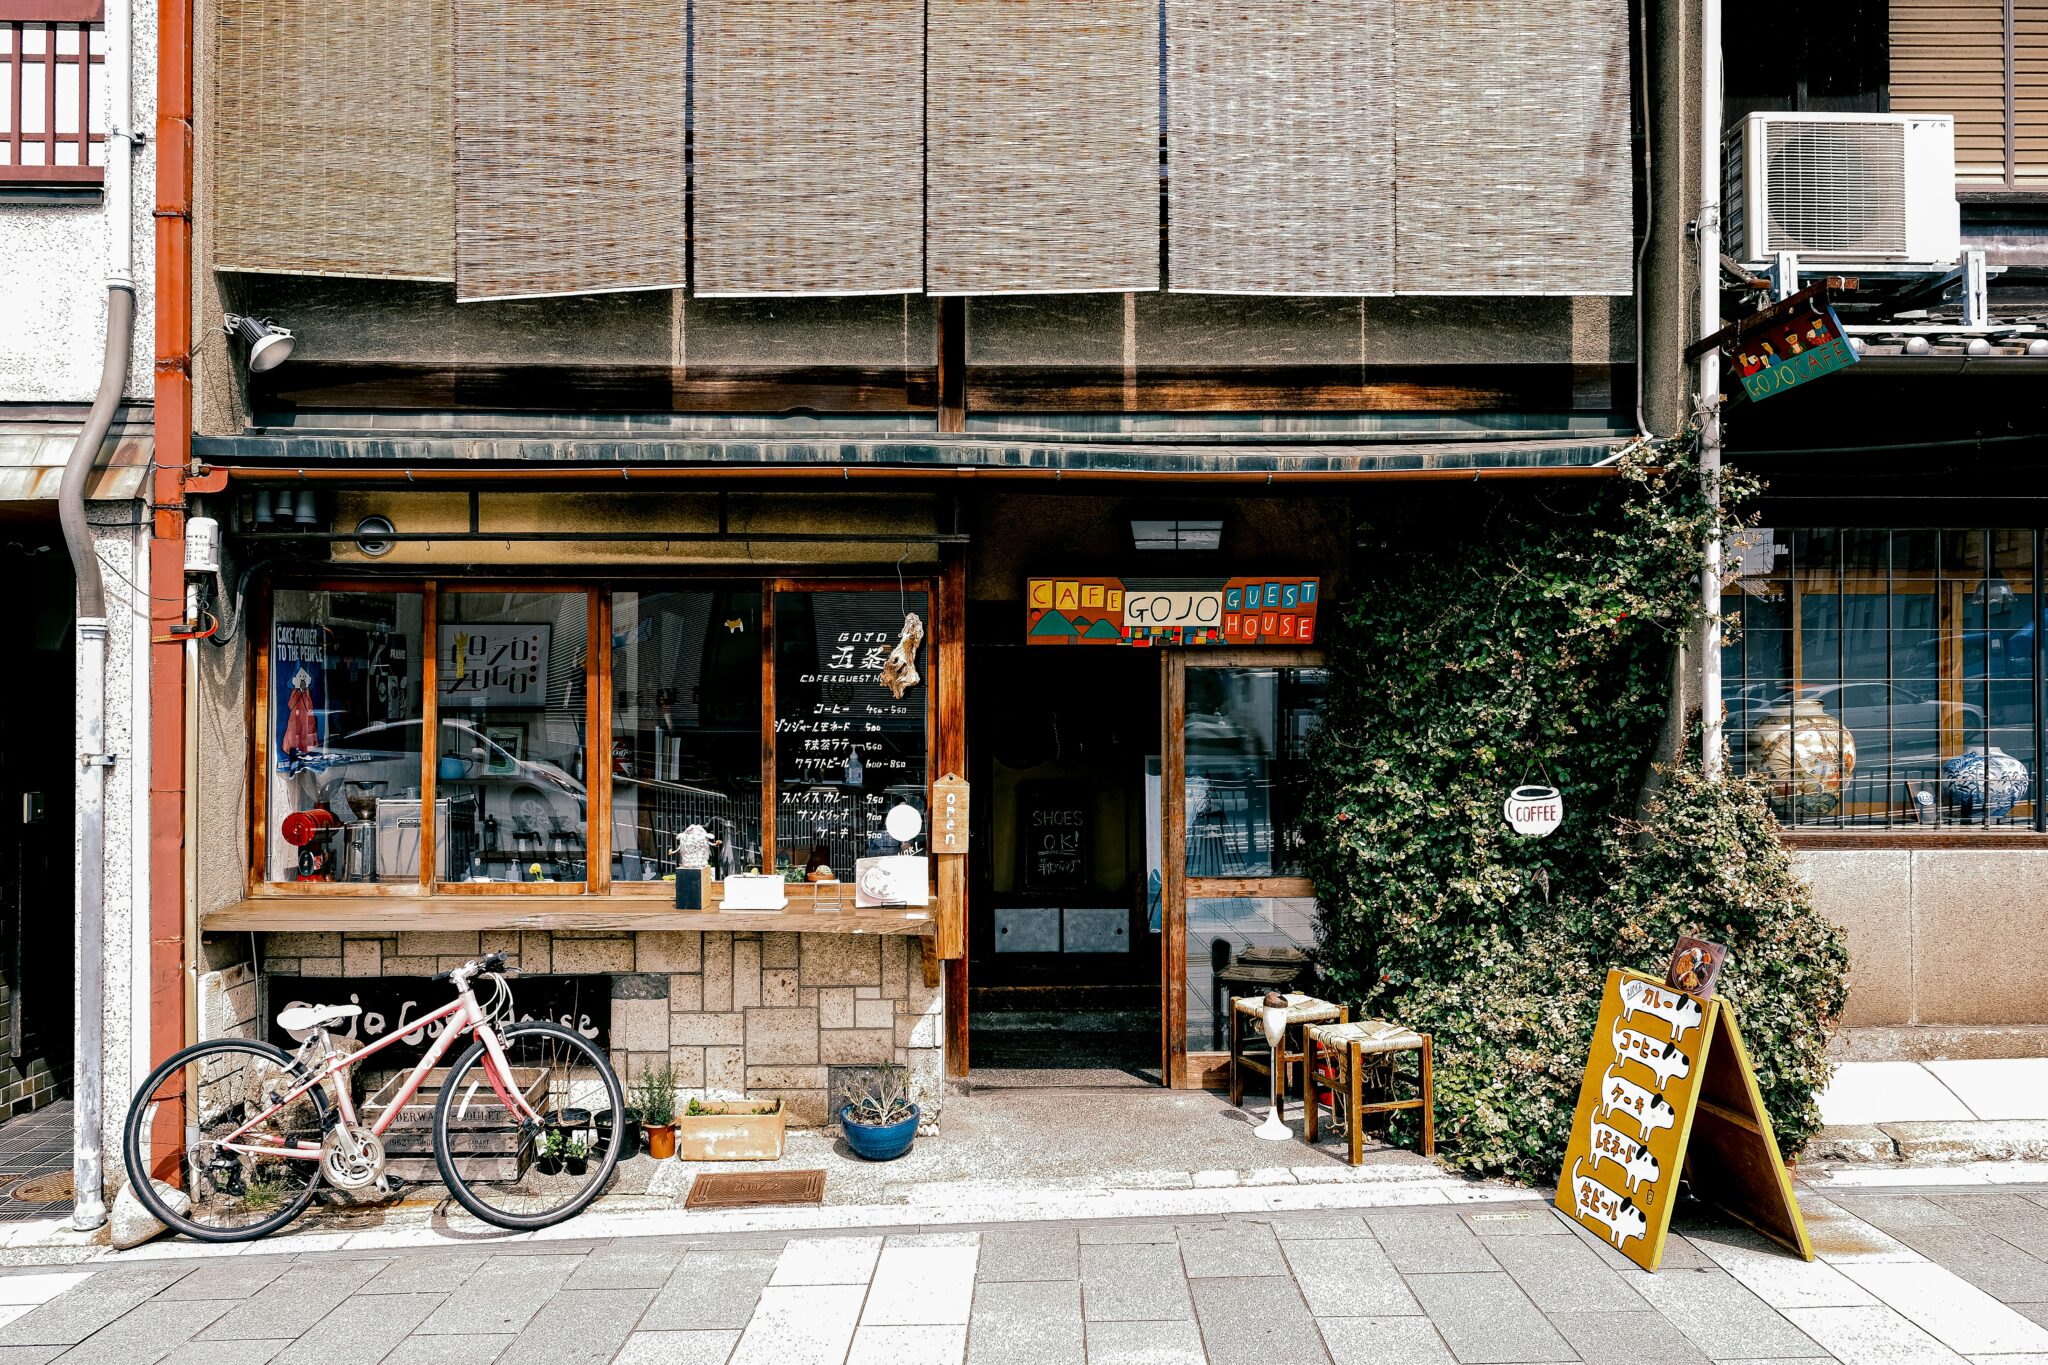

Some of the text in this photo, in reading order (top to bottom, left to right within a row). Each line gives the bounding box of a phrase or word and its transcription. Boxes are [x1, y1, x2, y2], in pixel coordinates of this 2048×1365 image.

[1746, 340, 1849, 397] GOJO CAFE
[1032, 582, 1120, 609] CAFE
[1227, 583, 1314, 608] GUEST
[1128, 596, 1219, 622] GOJO
[1226, 612, 1310, 638] HOUSE
[277, 627, 317, 645] CAKE POWER
[838, 632, 888, 642] GOJO
[278, 645, 324, 663] TO THE PEOPLE
[826, 645, 888, 670] 五条
[814, 704, 850, 714] コーヒー
[775, 719, 881, 733] ジンジャーレモネード 500
[804, 738, 850, 751] 抹茶ラテ
[795, 758, 906, 769] クラフトビール 600-850
[866, 794, 884, 804] 950
[797, 809, 882, 822] サンドイッチ 700
[1032, 810, 1084, 828] SHOES
[1516, 804, 1556, 822] COFFEE
[816, 827, 882, 840] ケーキ 500
[1043, 830, 1080, 850] OK!
[1642, 988, 1674, 1009] カレー
[1619, 1032, 1660, 1058] コーヒー
[1610, 1085, 1645, 1115] ケーキ
[1596, 1129, 1637, 1164] レモネード
[1580, 1180, 1618, 1220] 生ビール
